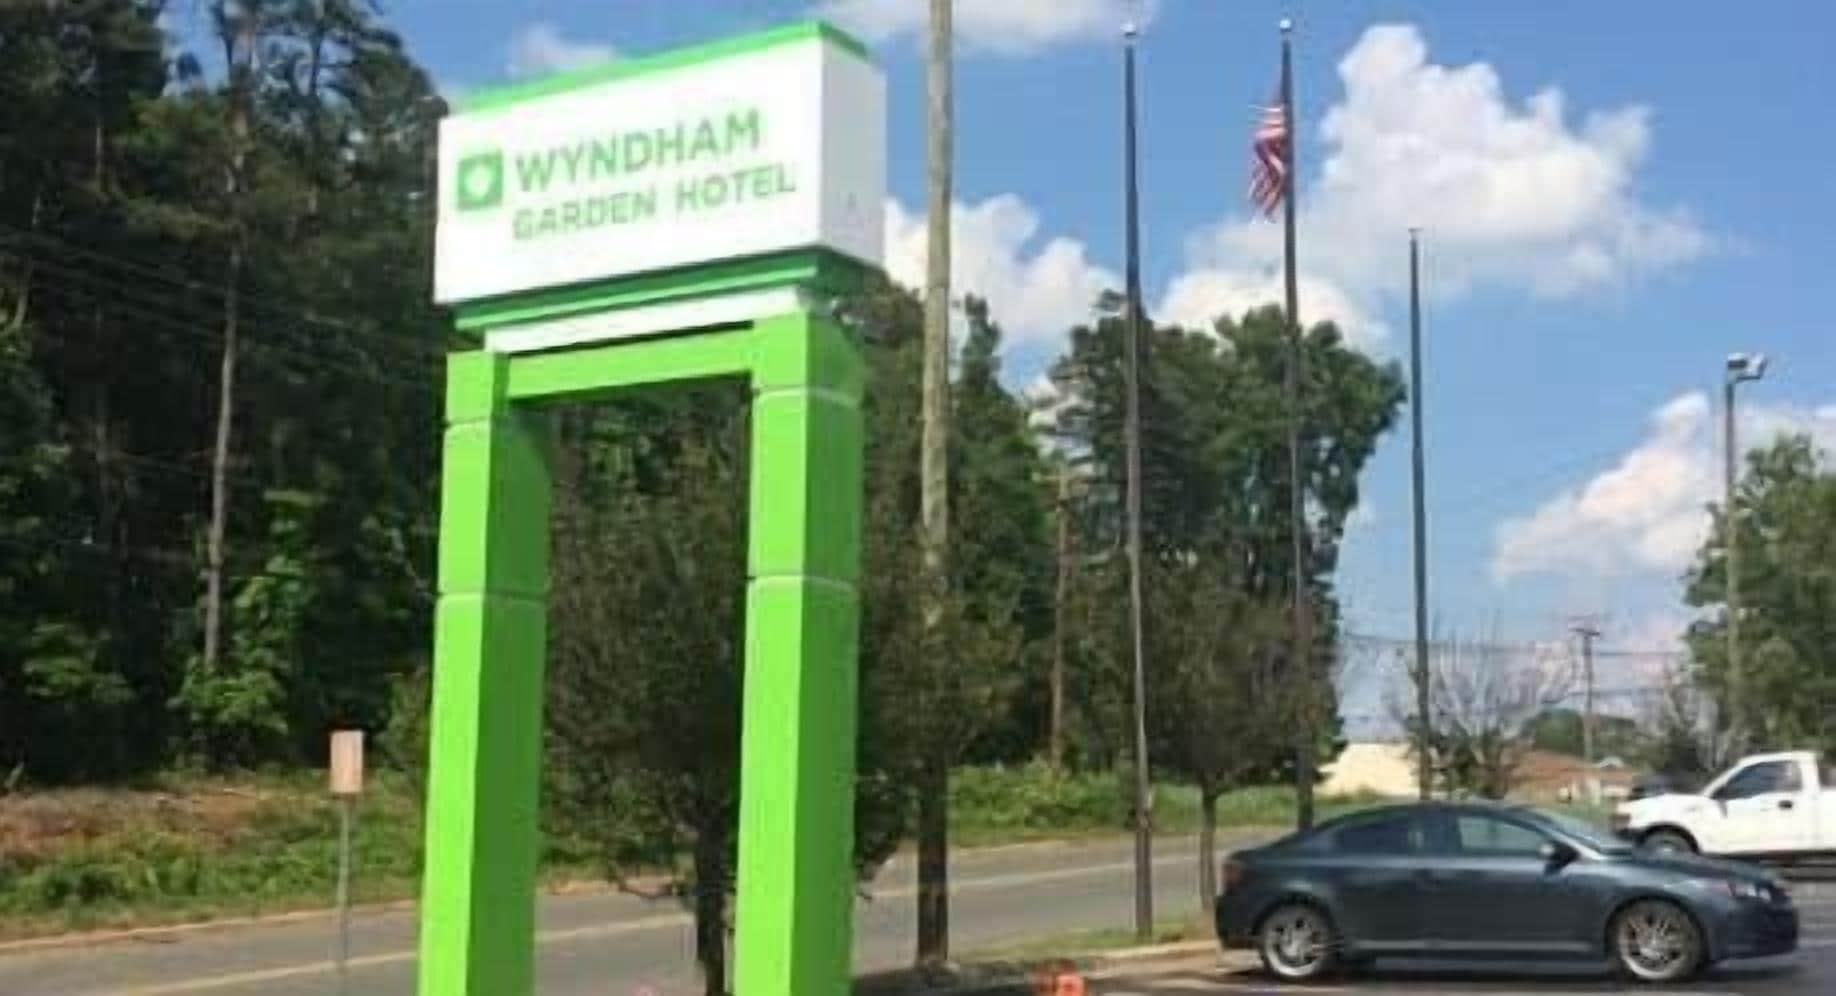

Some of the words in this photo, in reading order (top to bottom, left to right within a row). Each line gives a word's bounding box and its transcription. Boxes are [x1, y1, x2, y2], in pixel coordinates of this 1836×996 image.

[515, 108, 761, 193] WYNDHAM
[512, 186, 657, 240] GARDEN
[676, 162, 796, 215] HOTEL
